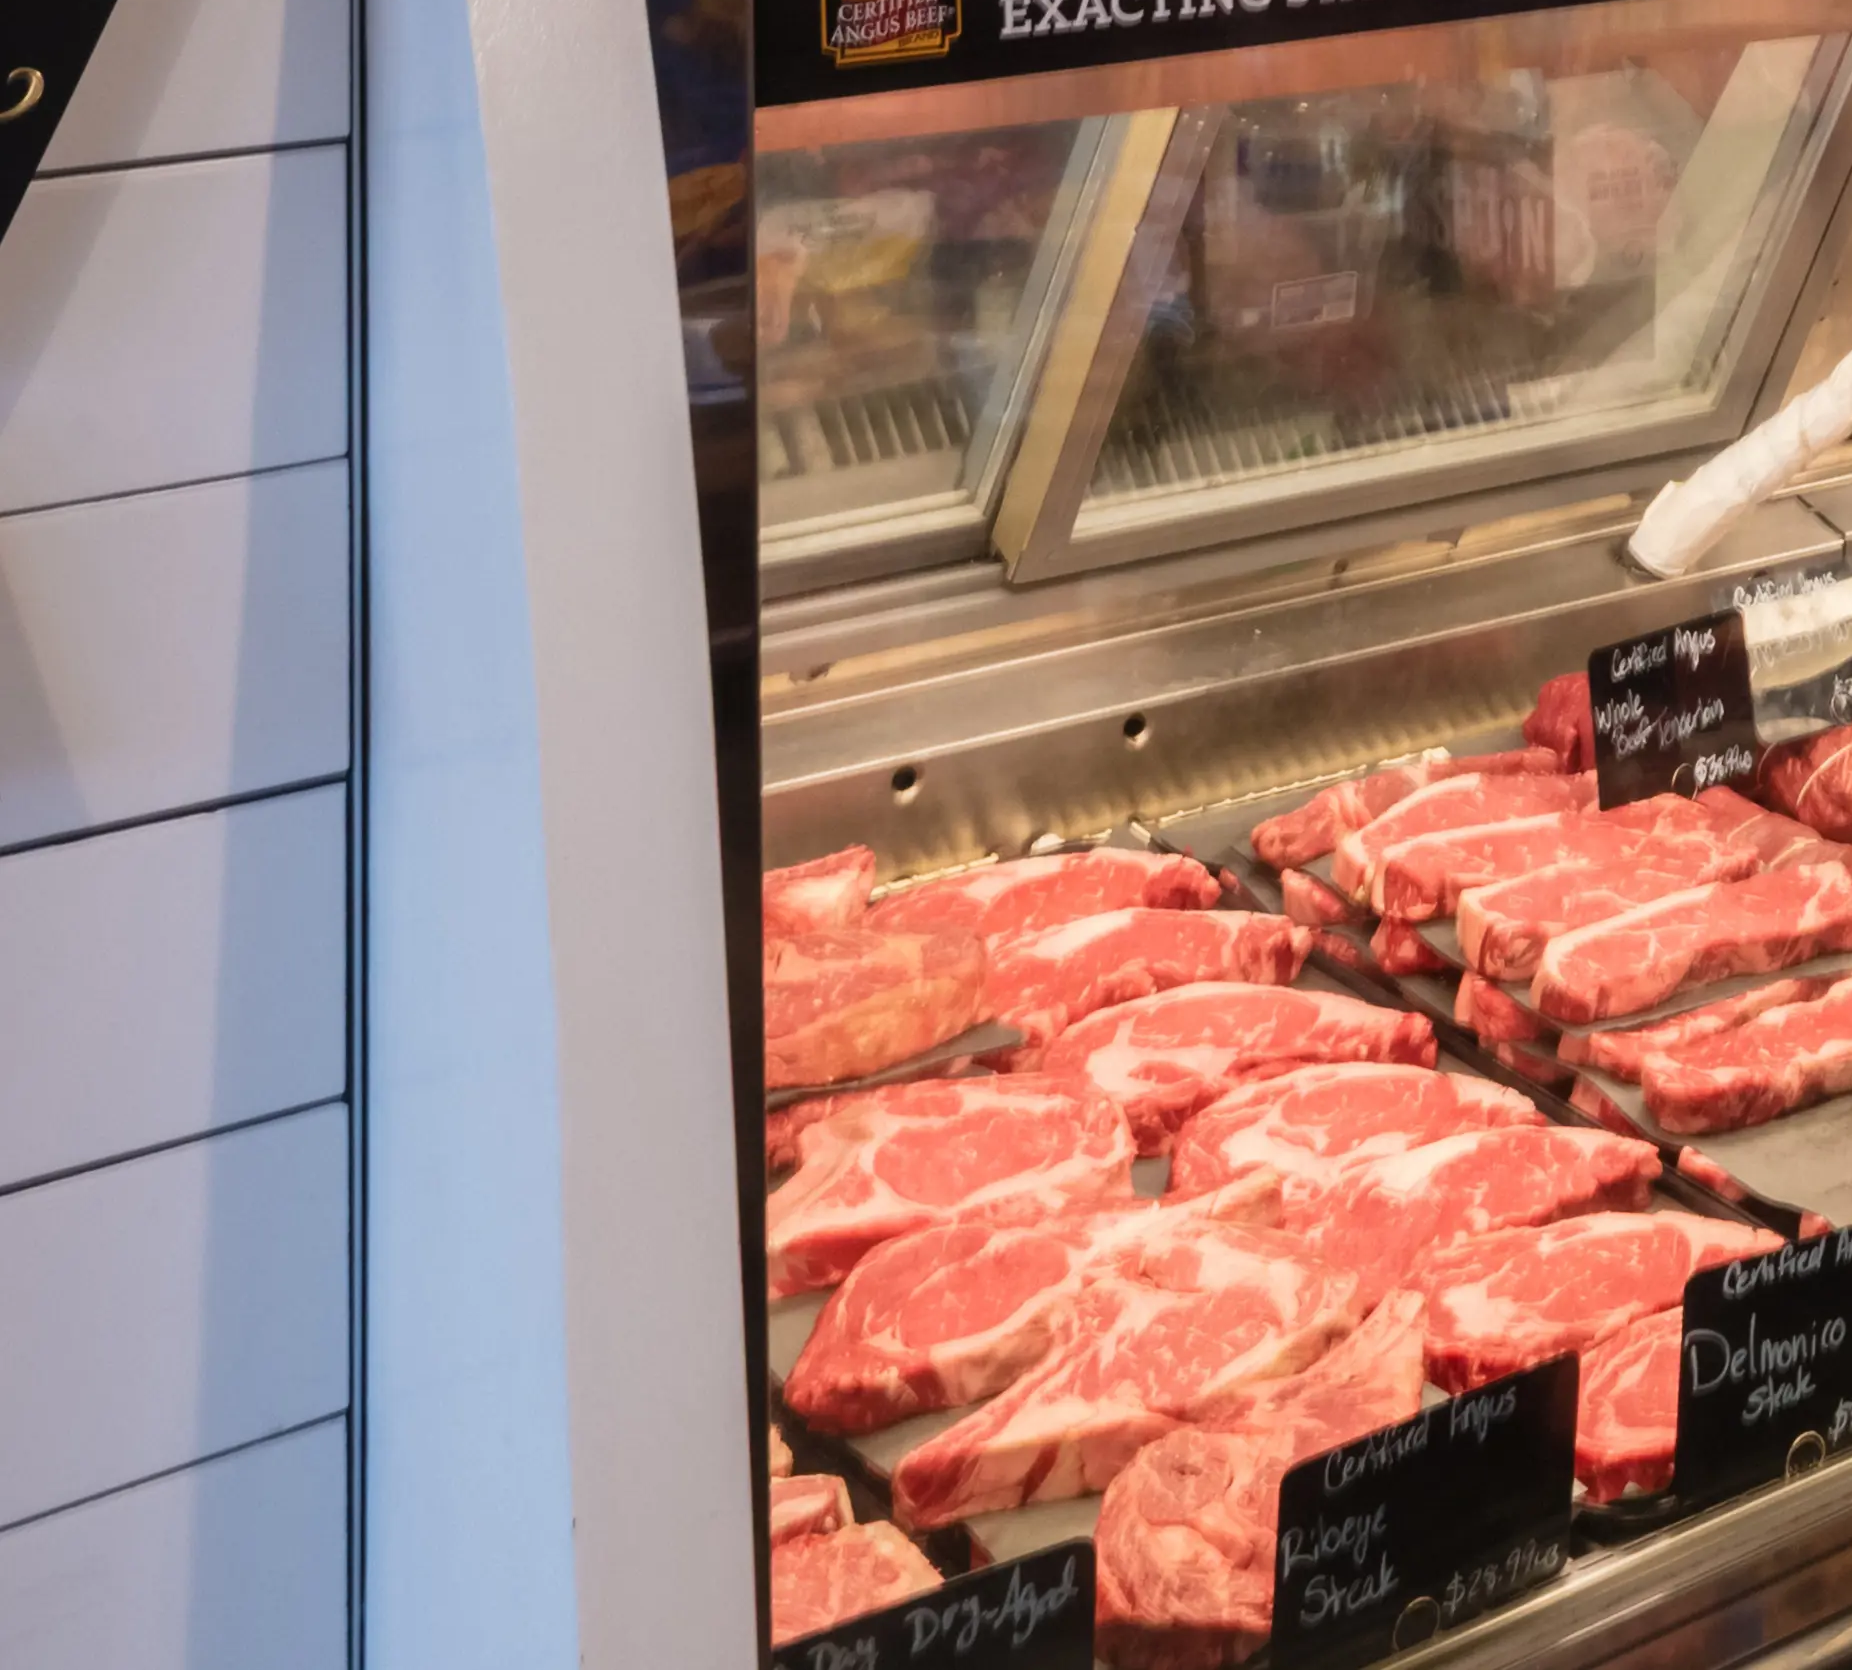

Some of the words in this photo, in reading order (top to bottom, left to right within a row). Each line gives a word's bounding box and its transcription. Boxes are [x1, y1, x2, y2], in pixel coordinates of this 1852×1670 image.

[830, 14, 900, 47] ANGUS
[905, 6, 948, 31] BEEF
[1674, 628, 1716, 671] Angus
[1723, 1236, 1826, 1300] Certified
[1685, 1312, 1846, 1394] Delmonico
[1449, 1385, 1518, 1445] Angus
[1282, 1504, 1388, 1576] Ribeye
[1301, 1563, 1398, 1625] Steak
